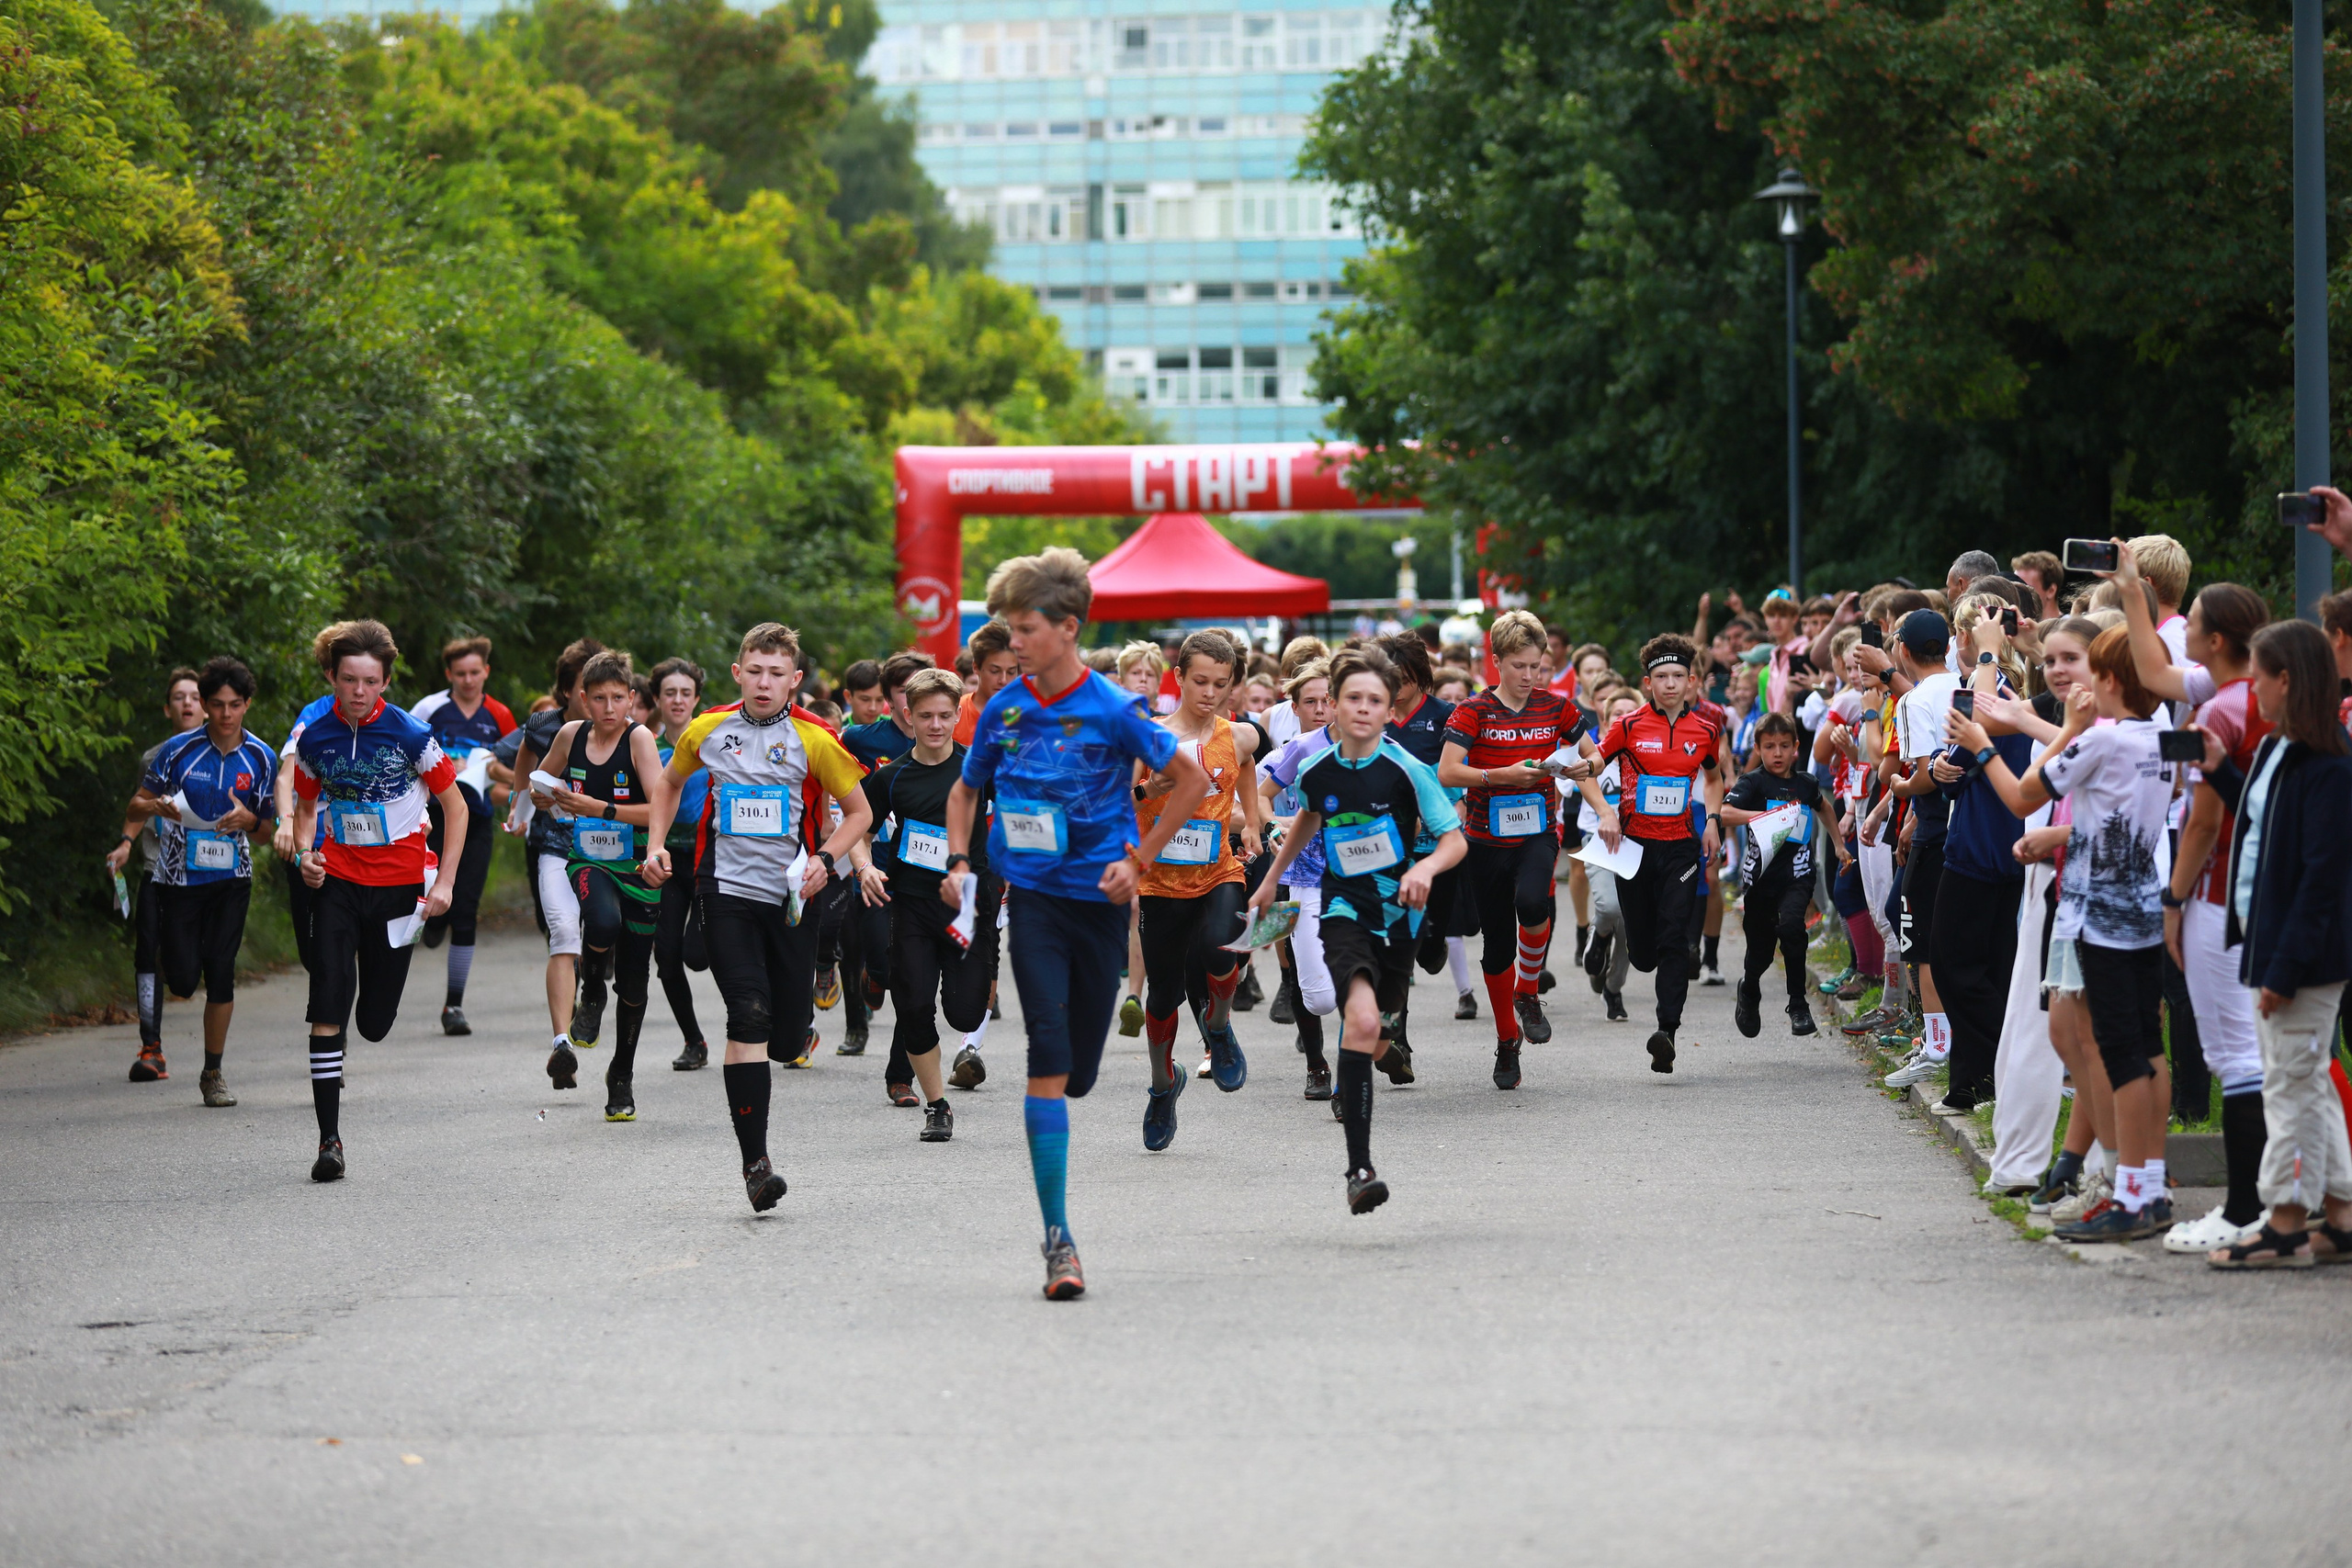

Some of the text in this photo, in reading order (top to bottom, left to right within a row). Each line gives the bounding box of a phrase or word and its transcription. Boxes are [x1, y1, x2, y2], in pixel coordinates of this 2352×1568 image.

[1131, 448, 1301, 512] СТАРТ
[1647, 655, 1678, 670] noname
[1480, 728, 1516, 741] NORD
[1520, 726, 1557, 740] WEST
[1652, 795, 1677, 806] 321.1
[738, 807, 770, 818] 310.1
[1506, 811, 1531, 824] 300.1
[346, 821, 371, 831] 330.1
[1011, 820, 1044, 833] 307.1
[590, 835, 616, 846] 309.1
[1169, 835, 1199, 847] 305.1
[201, 846, 224, 857] 340.1
[911, 840, 938, 855] 317.1
[1346, 842, 1380, 858] 306.1
[1679, 863, 1698, 883] noname
[1900, 895, 1913, 953] FILA
